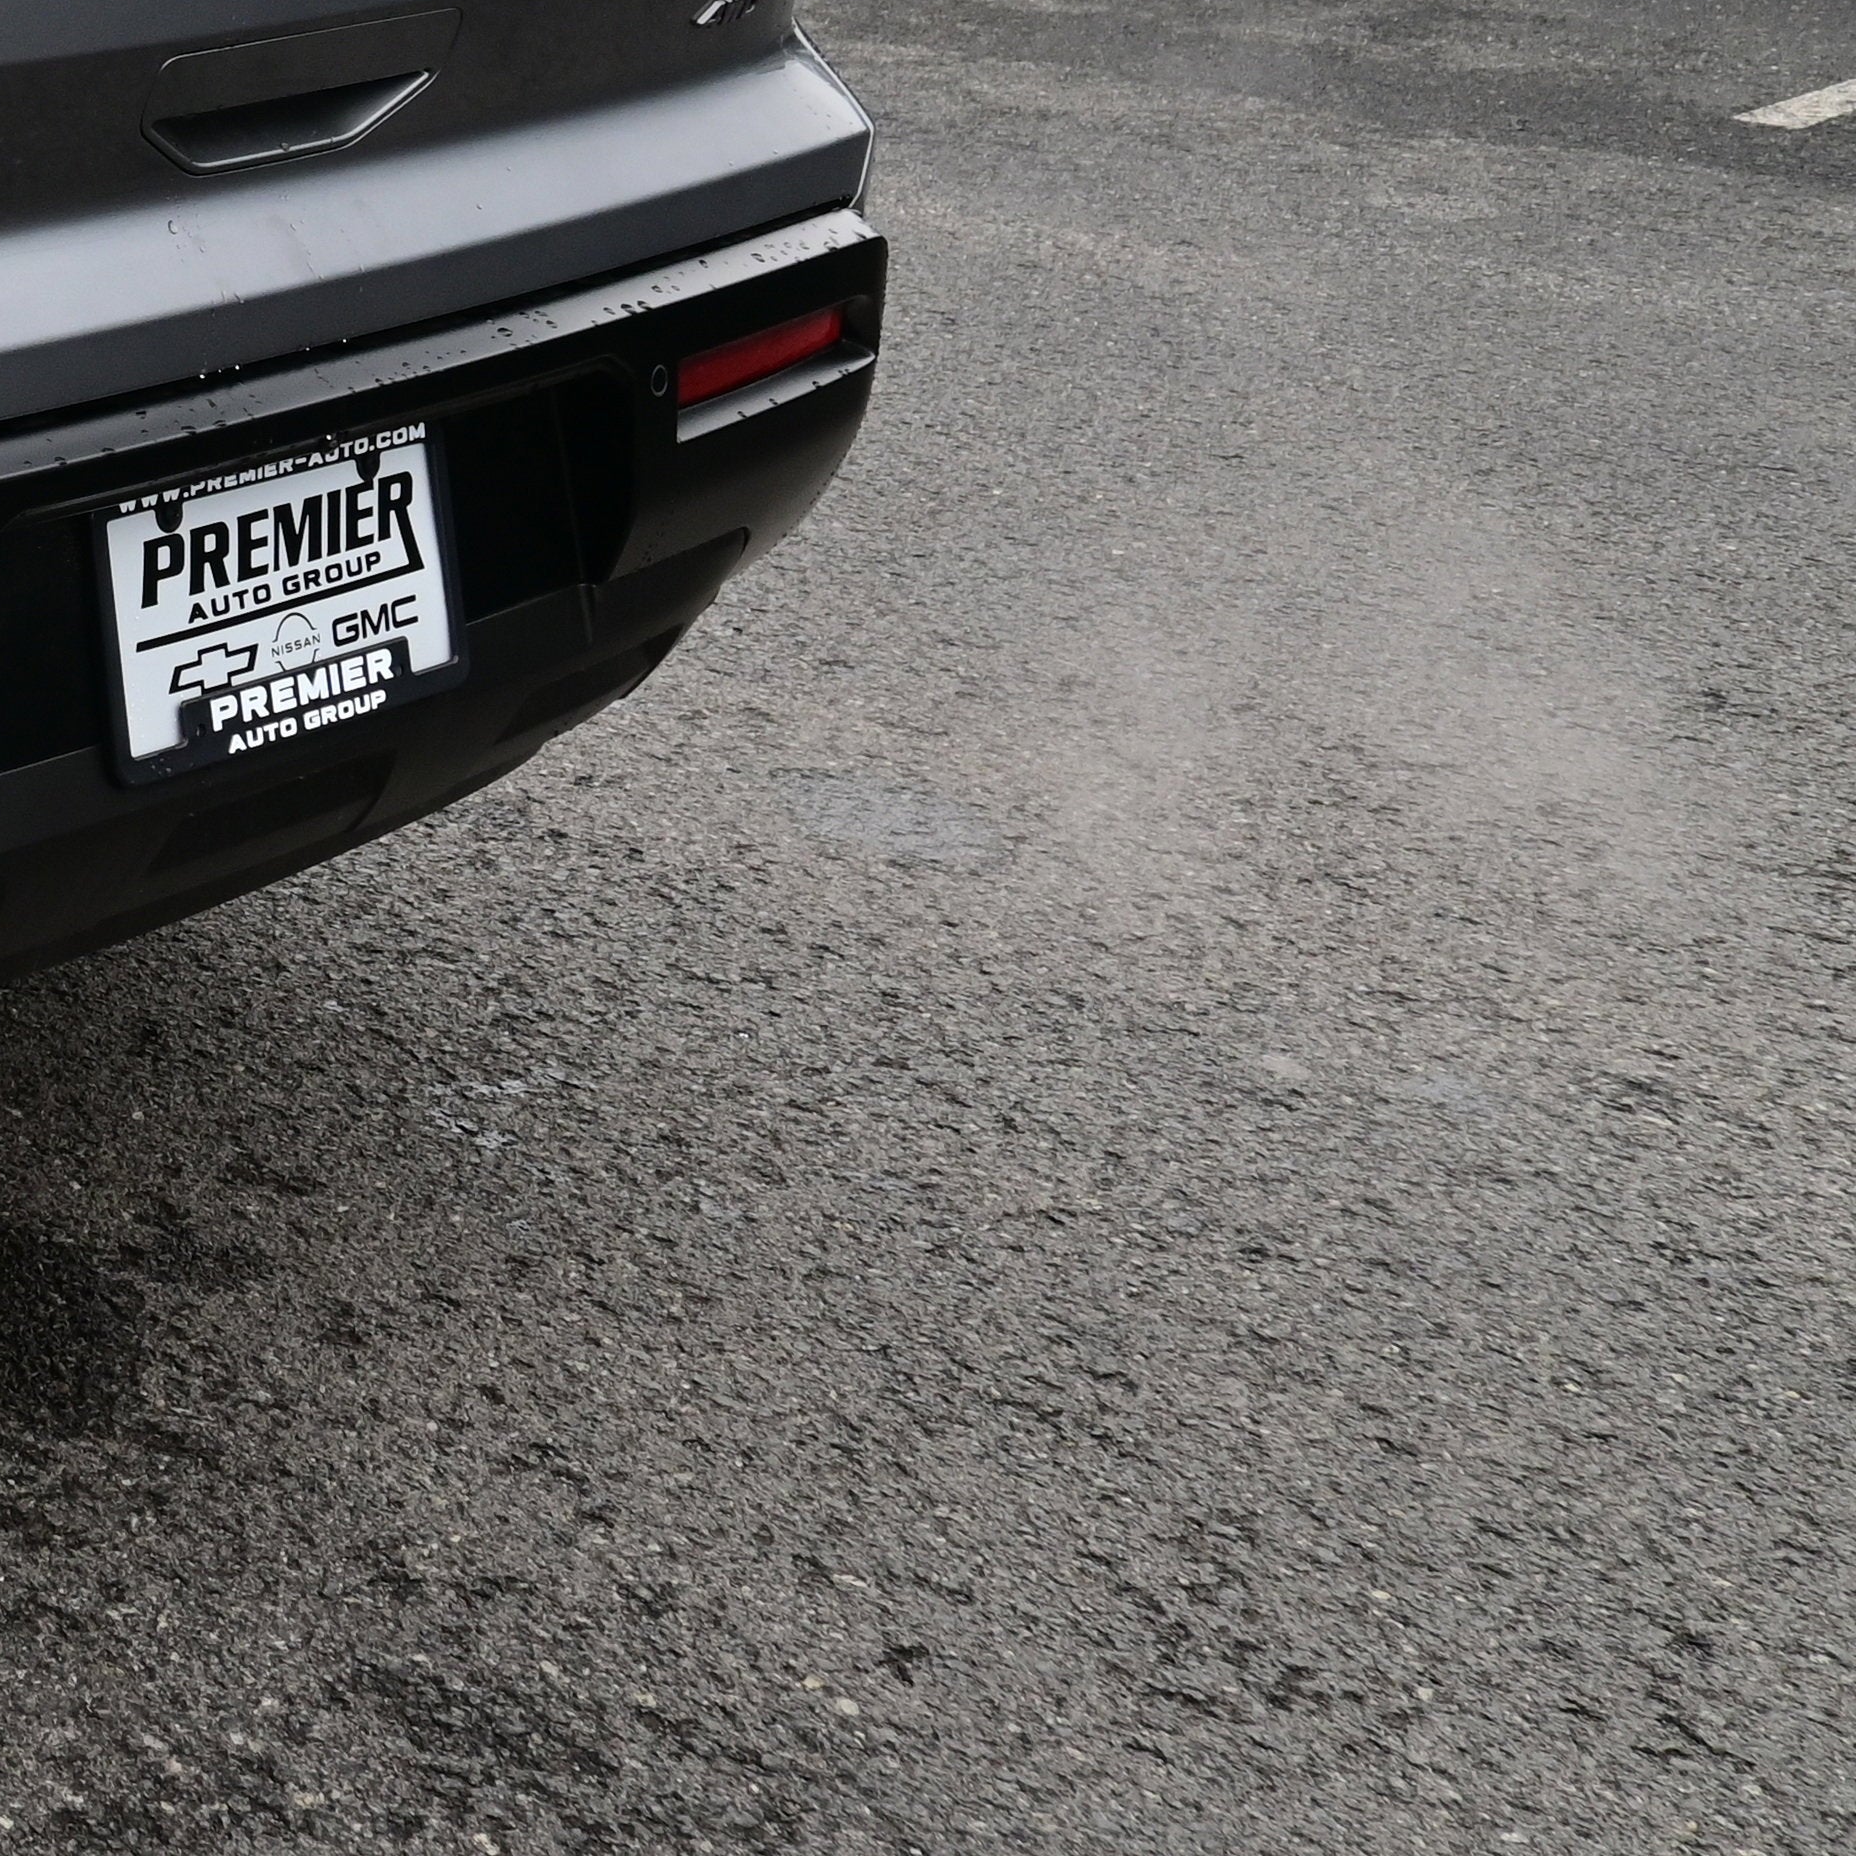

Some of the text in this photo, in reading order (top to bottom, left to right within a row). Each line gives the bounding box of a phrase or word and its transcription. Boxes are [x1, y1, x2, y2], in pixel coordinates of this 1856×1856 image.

[141, 471, 425, 609] PREMIER
[188, 551, 382, 624] AUTO GROUP
[332, 595, 420, 647] GMC
[271, 633, 322, 658] NISSAN
[210, 648, 394, 732] PREMIER
[228, 689, 387, 754] AUTO GROUP
